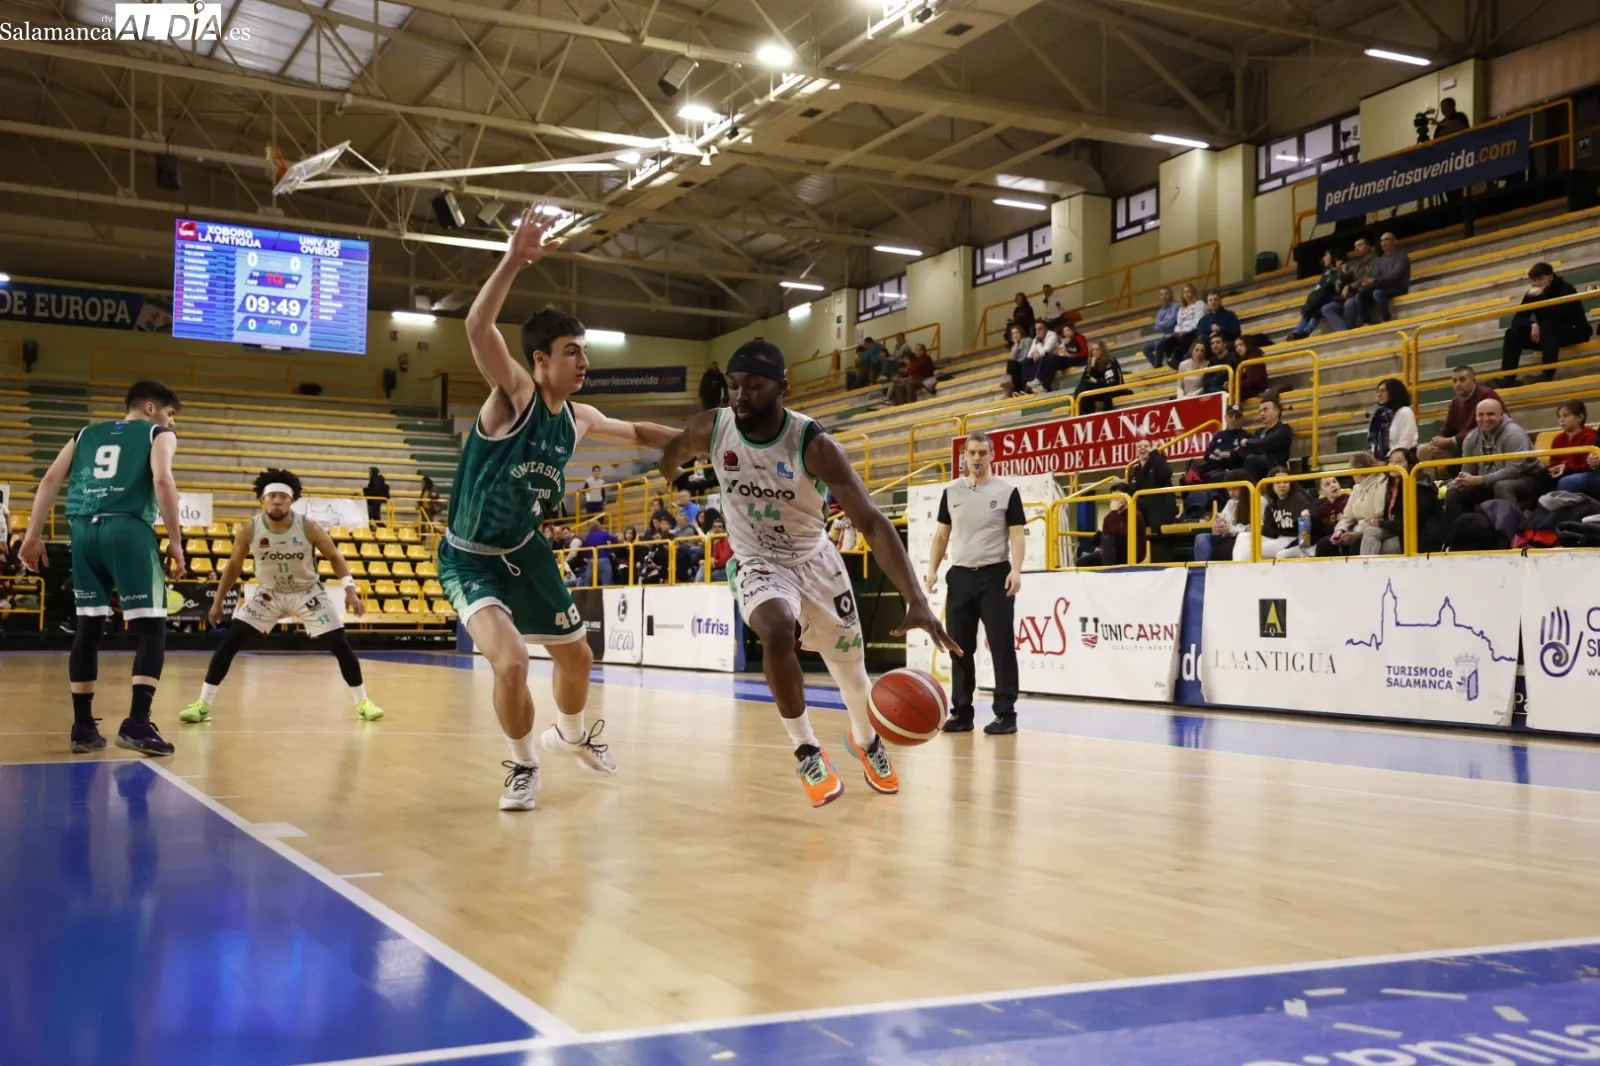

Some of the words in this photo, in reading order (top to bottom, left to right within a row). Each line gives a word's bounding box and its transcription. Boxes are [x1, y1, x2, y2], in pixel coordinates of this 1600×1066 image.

[1324, 138, 1517, 211] perfumeriasavenida.com
[198, 232, 212, 243] LA
[213, 235, 262, 248] ANTIGUA
[207, 225, 254, 239] XOBORG
[299, 236, 324, 247] UNIV.
[326, 240, 341, 250] DE
[300, 245, 339, 257] OVIEDO
[247, 252, 258, 267] 0
[290, 256, 301, 271] 0
[34, 293, 132, 324] EUROPA
[245, 295, 301, 317] 09:49
[248, 318, 257, 331] 0
[289, 323, 298, 335] 0
[1002, 406, 1185, 456] SALAMANCA
[93, 444, 122, 479] 9
[992, 452, 1059, 477] TRIMONIO
[1063, 448, 1084, 470] DE
[1088, 445, 1108, 467] LA
[747, 503, 781, 521] 44
[554, 603, 582, 630] 48
[834, 632, 863, 653] 44
[1386, 678, 1453, 690] SALAMANCA
